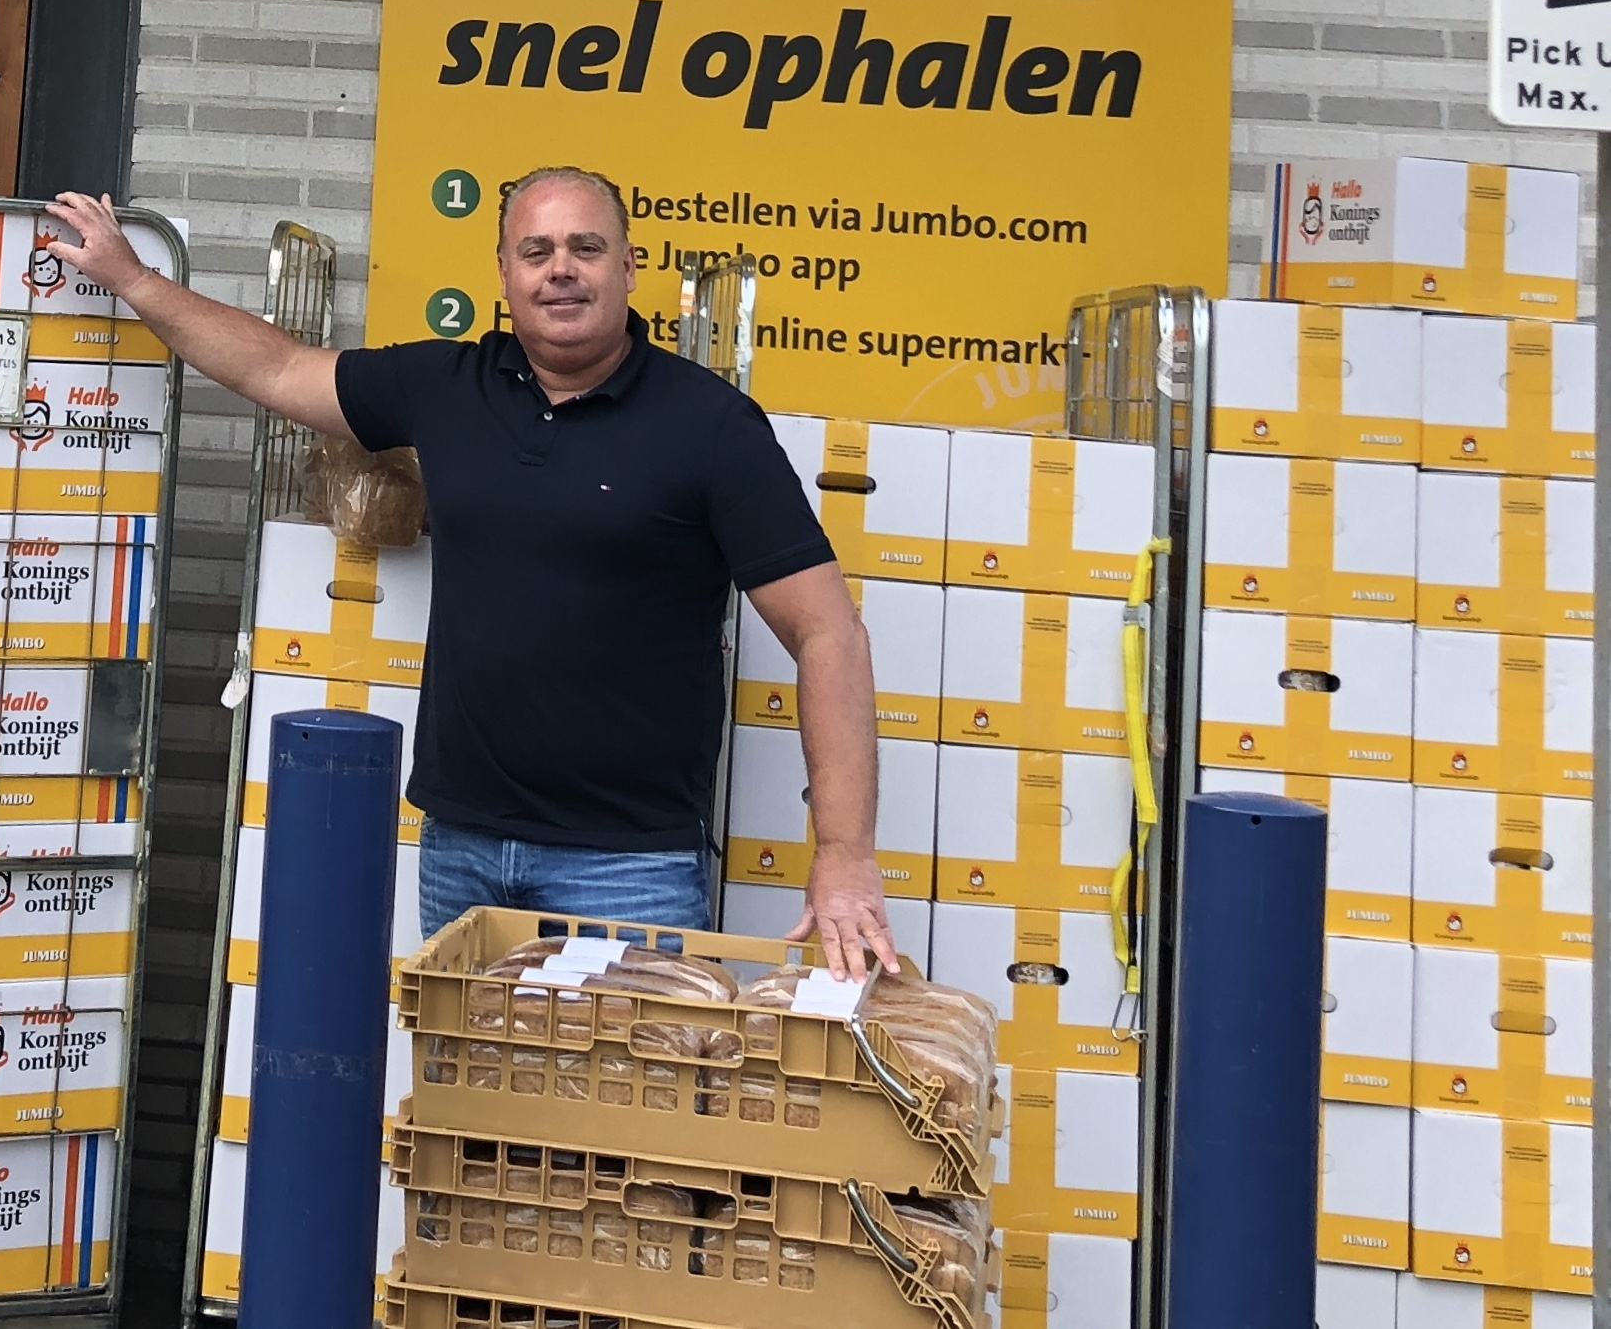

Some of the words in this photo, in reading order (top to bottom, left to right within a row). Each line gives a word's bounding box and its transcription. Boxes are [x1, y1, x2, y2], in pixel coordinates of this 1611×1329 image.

[1507, 37, 1581, 66] Pick
[1597, 42, 1611, 67] U
[438, 0, 663, 93] snel
[681, 8, 1142, 130] ophalen
[1518, 82, 1599, 111] Max.
[446, 179, 467, 209] 1
[1331, 180, 1362, 199] Hallo
[631, 186, 796, 227] bestellen
[807, 198, 861, 231] via
[871, 202, 1087, 244] Jumbo.com
[1329, 203, 1380, 224] Konings
[1329, 225, 1370, 244] ontbijt
[791, 256, 860, 291] app
[439, 297, 461, 328] 2
[73, 332, 119, 344] JUMBO
[734, 316, 847, 352] nline
[67, 387, 119, 406] Hallo
[65, 409, 148, 431] Konings
[63, 432, 131, 454] ontbijt
[60, 484, 107, 497] JUMBO
[6, 537, 60, 557] Hallo
[2, 561, 89, 584] Konings
[1, 582, 72, 605] ontbijt
[26, 873, 113, 893] Konings
[881, 869, 910, 880] MBO
[25, 892, 96, 915] ontbijt
[22, 950, 69, 963] JUMBO
[19, 1028, 106, 1050] Konings
[18, 1049, 89, 1072] ontbijt
[1565, 1095, 1592, 1107] JUM
[16, 1106, 63, 1121] JUMBO
